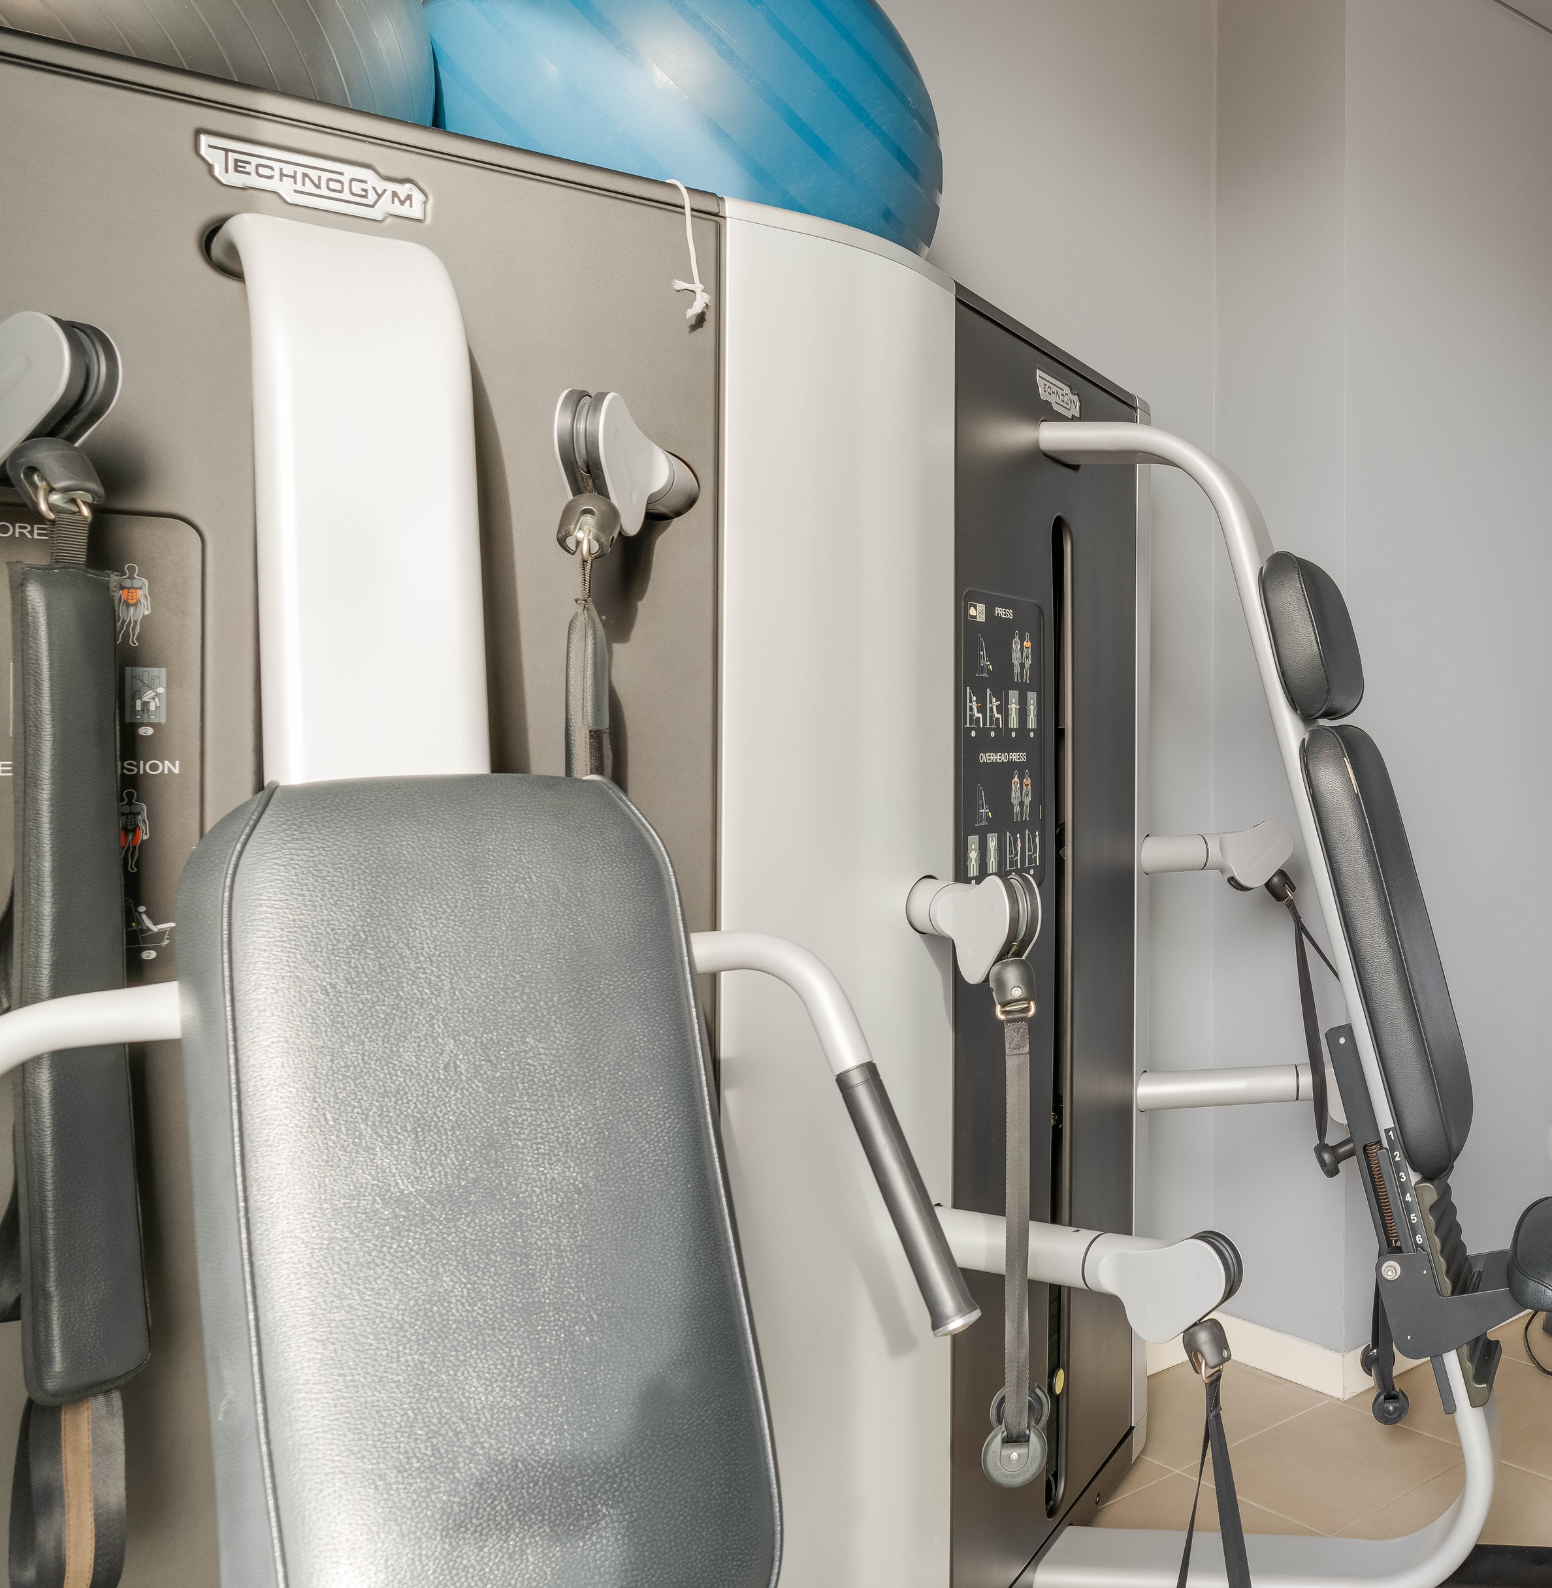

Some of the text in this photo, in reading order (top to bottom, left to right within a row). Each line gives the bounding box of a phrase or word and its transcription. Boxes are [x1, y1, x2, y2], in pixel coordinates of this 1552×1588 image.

[207, 143, 414, 209] TECHNOGYM
[995, 606, 1014, 619] PRESS
[979, 752, 1027, 762] OVERHEAD PRESS
[1388, 1130, 1394, 1140] 1
[1394, 1151, 1401, 1161] 2
[1399, 1172, 1406, 1181] 3
[1405, 1193, 1412, 1202] 4
[1410, 1213, 1417, 1223] 5
[1416, 1234, 1423, 1244] 6
